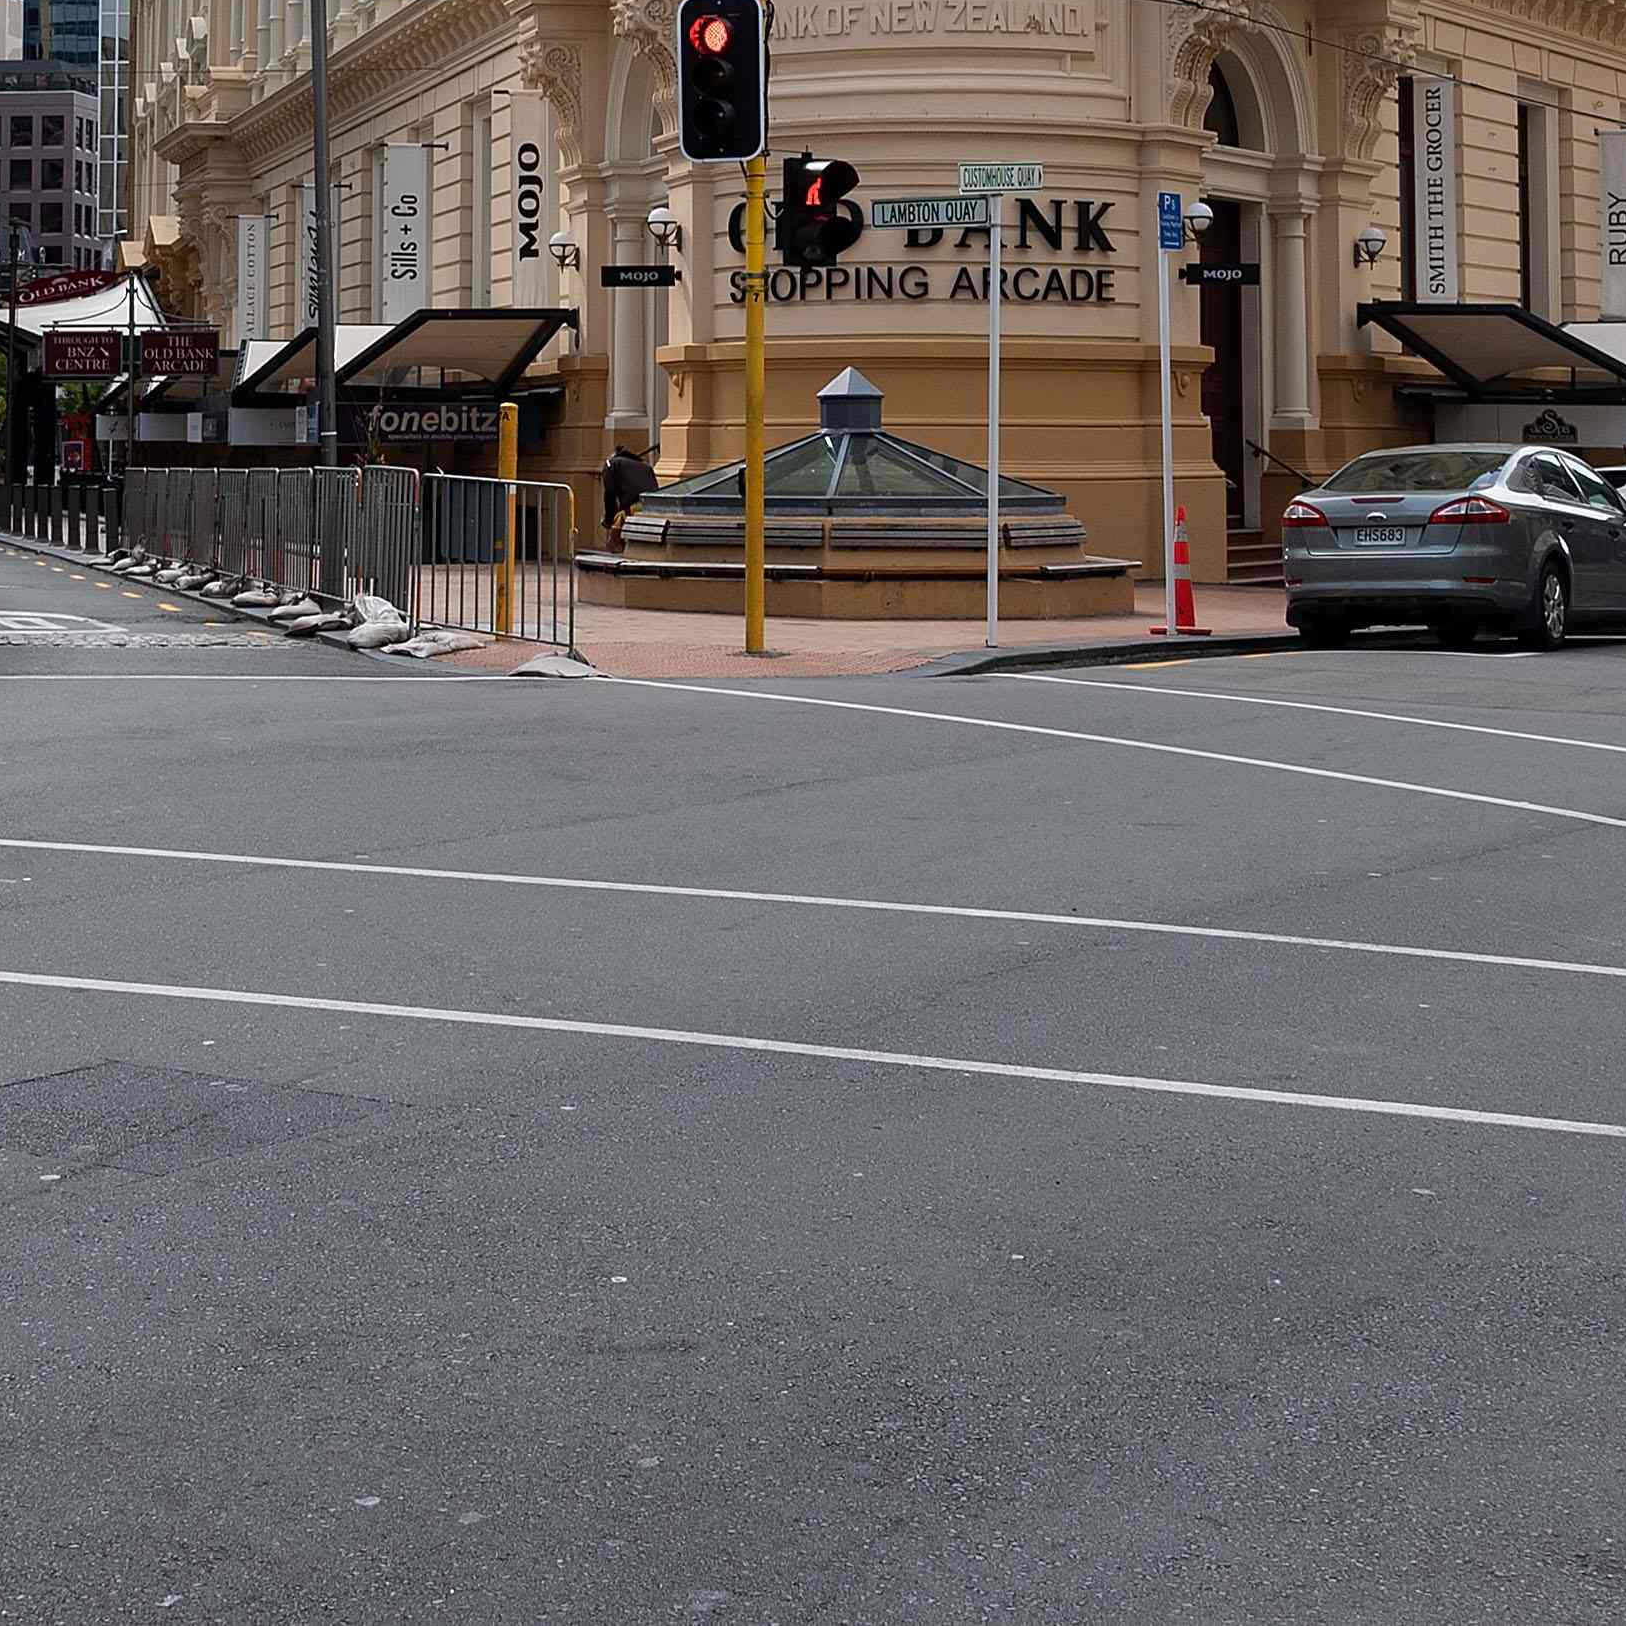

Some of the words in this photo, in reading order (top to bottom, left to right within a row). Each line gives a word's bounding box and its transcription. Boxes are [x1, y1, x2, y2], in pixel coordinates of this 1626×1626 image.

[825, 4, 865, 36] OF
[871, 1, 940, 34] NEW
[1426, 87, 1443, 172] GROCER
[963, 167, 1015, 188] CUSTOMHOUSE
[1017, 167, 1036, 187] QUAY
[391, 194, 418, 218] Co
[518, 143, 543, 262] MOJO
[881, 201, 941, 224] LAMBTON
[945, 199, 978, 222] QUAY
[1428, 177, 1444, 222] THE
[400, 224, 412, 235] +
[247, 224, 256, 278] COTTON
[391, 241, 418, 281] Sills
[1429, 226, 1445, 294] SMITH
[620, 271, 659, 283] MOJO
[730, 266, 930, 305] SOPPING
[1203, 270, 1242, 281] MOJO
[18, 285, 55, 303] OLD
[58, 275, 106, 294] BANK
[53, 336, 100, 345] THROUGH
[102, 336, 114, 345] TO
[67, 347, 95, 358] BNZ
[167, 336, 192, 347] THE
[55, 358, 110, 370] CENTRE
[144, 348, 173, 359] OLD
[176, 348, 214, 359] BANK
[152, 360, 207, 371] ARCADE
[368, 405, 498, 433] fonebitz
